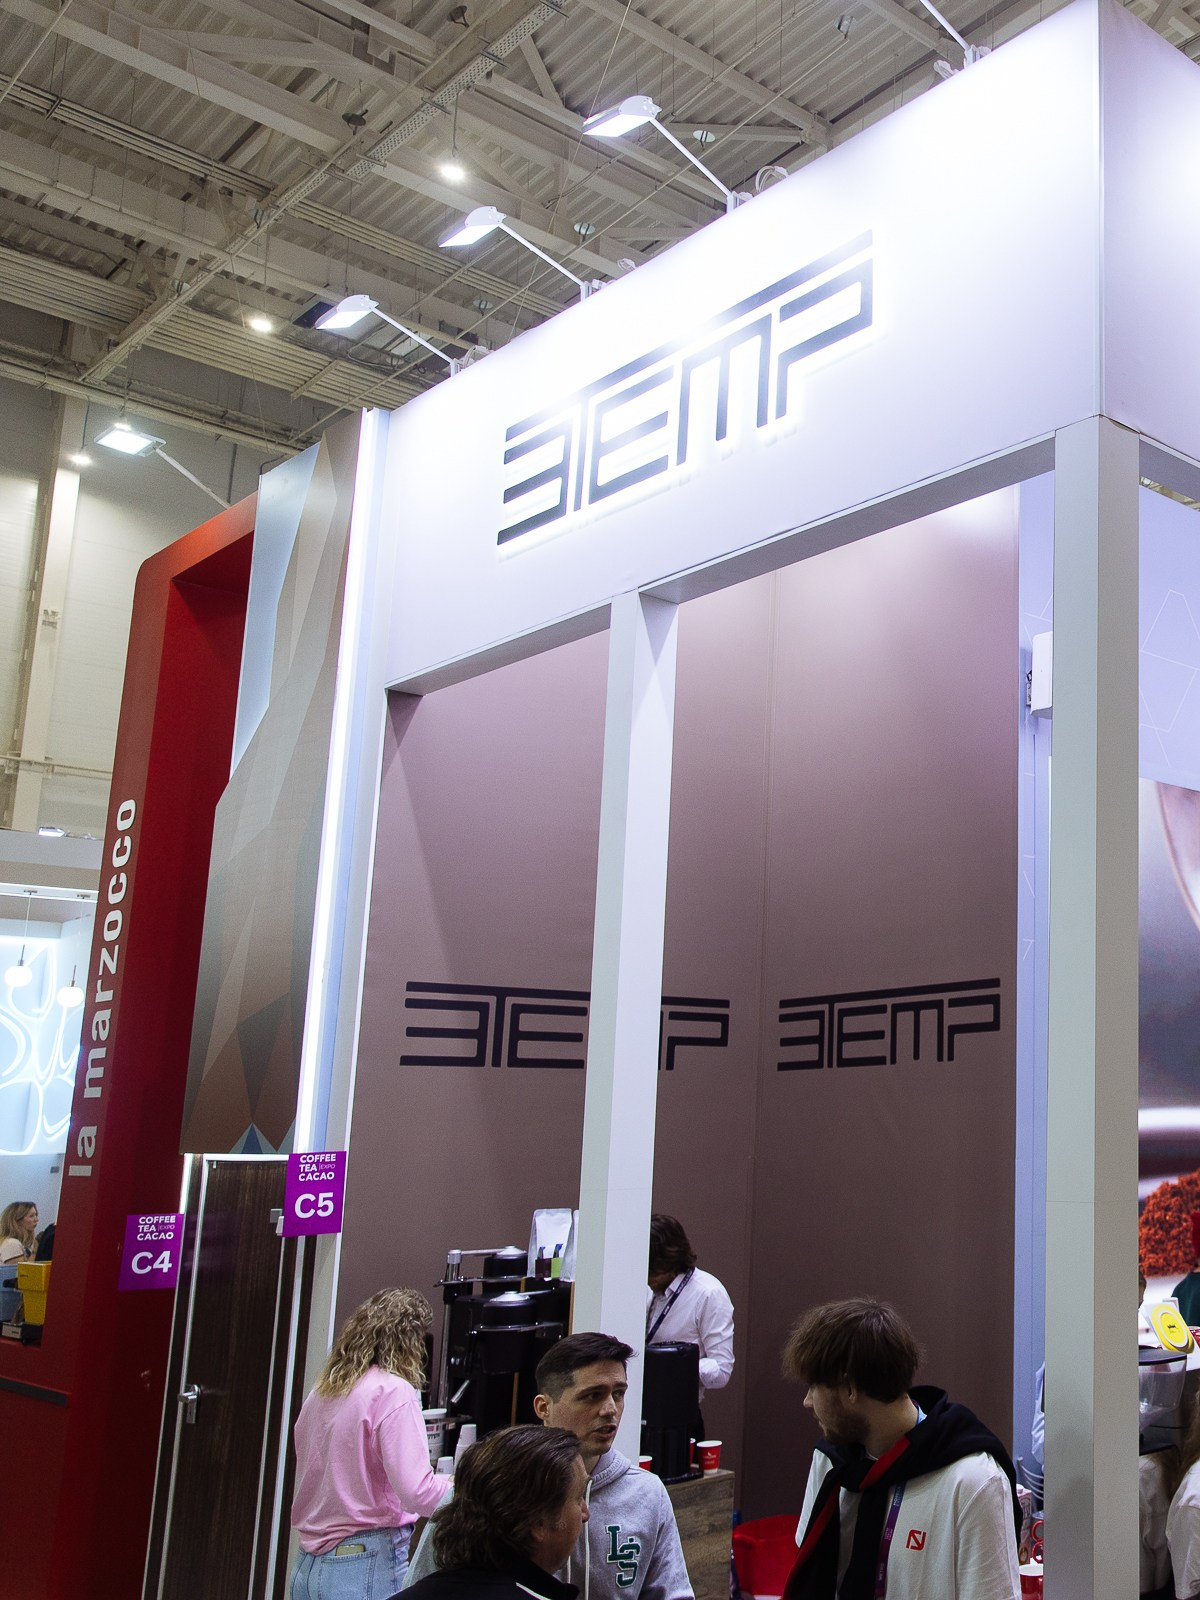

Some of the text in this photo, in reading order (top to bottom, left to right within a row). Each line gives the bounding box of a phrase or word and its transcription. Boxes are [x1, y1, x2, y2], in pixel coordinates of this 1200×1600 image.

[68, 798, 137, 1176] la marzocco
[400, 981, 730, 1071] 3TEP
[300, 1153, 337, 1163] COFFEE
[299, 1164, 317, 1172] TEA
[298, 1171, 335, 1181] CACAO
[294, 1191, 334, 1219] C5
[139, 1215, 176, 1224] COFFEE
[138, 1224, 156, 1233] TEA
[137, 1231, 174, 1241] CACAO
[131, 1250, 173, 1275] C4
